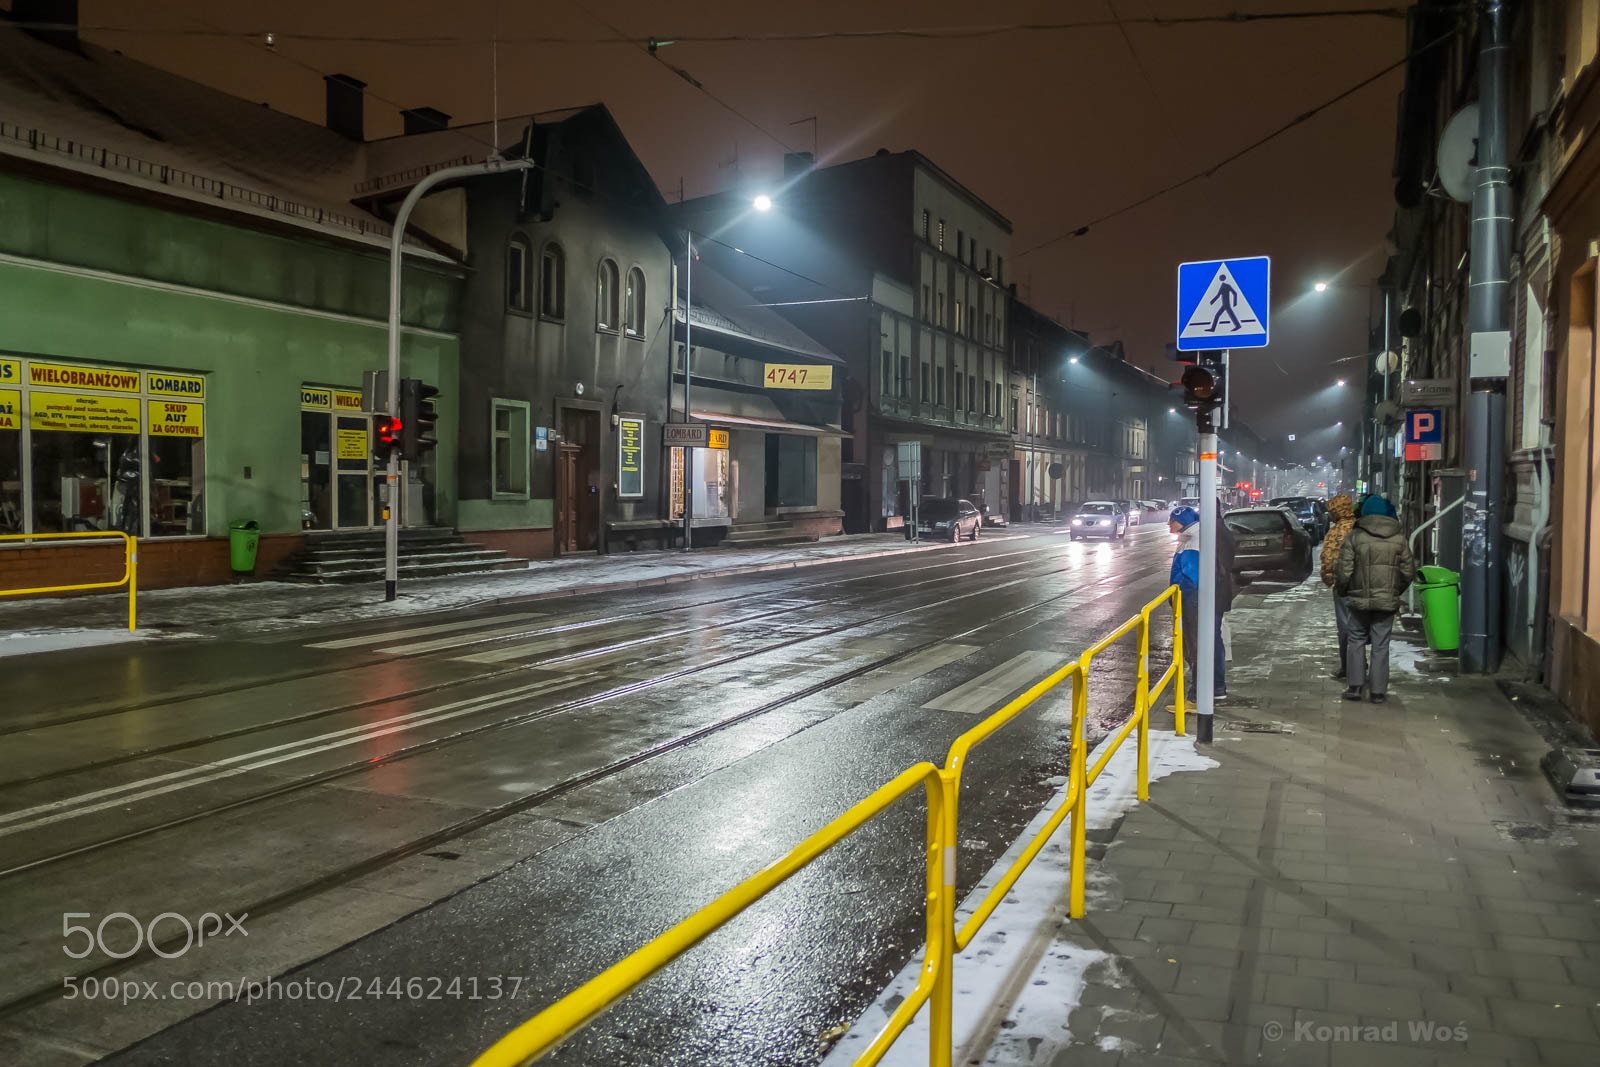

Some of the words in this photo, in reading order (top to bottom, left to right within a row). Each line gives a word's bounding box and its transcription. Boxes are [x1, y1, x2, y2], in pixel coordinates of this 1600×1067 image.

[31, 368, 137, 389] WIELOBRANŻOWY
[767, 368, 808, 385] 4747
[149, 377, 201, 394] LOMBARD
[164, 403, 188, 413] SKUP
[165, 413, 187, 423] AUT
[152, 424, 163, 434] ZA
[666, 428, 702, 439] LOMBARD
[1413, 413, 1435, 440] P
